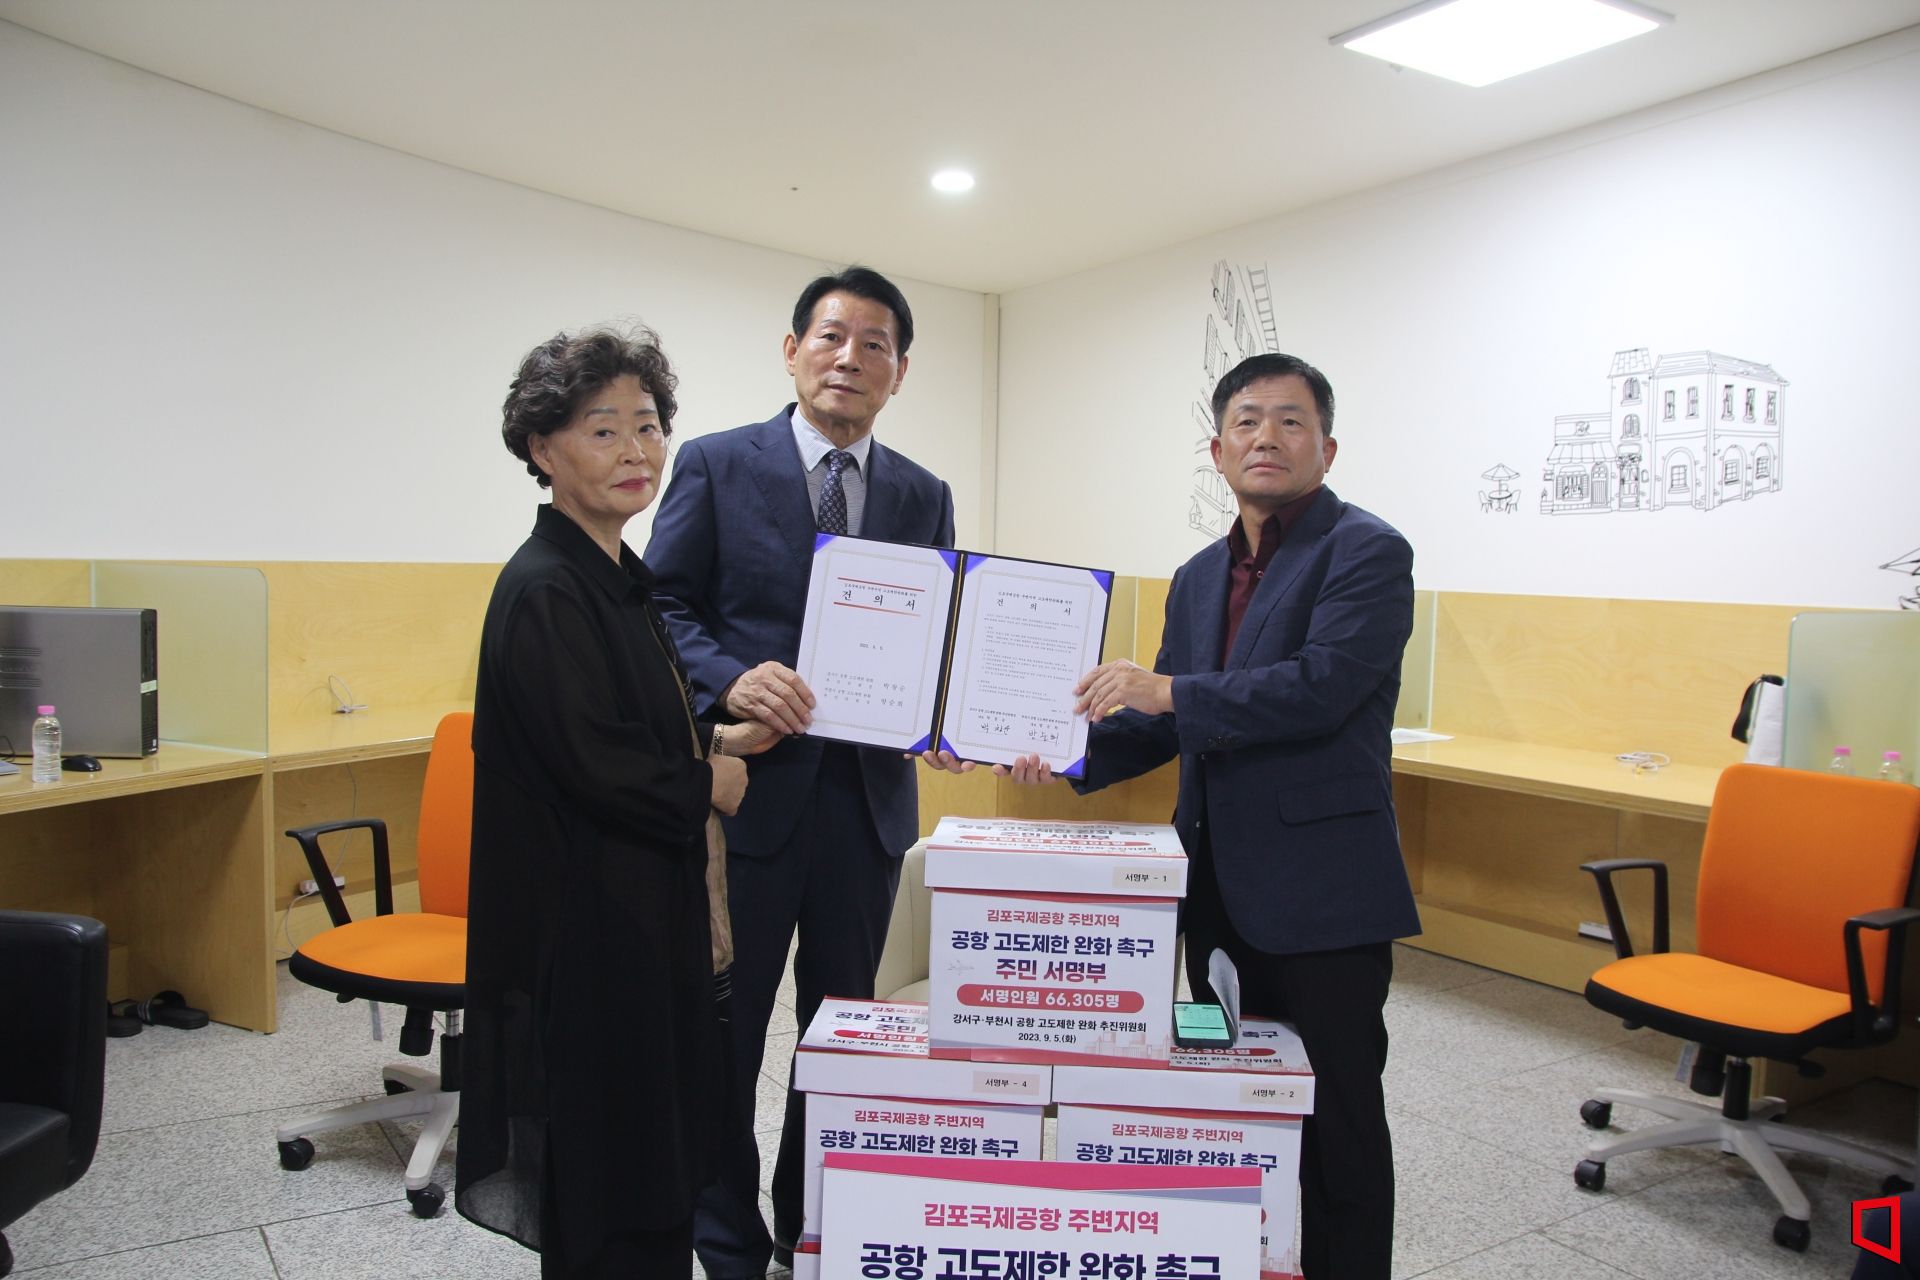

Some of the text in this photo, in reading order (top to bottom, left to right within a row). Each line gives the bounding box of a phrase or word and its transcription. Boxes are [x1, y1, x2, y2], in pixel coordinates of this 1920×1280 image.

[874, 595, 883, 606] 의
[905, 600, 915, 610] 서
[1125, 874, 1149, 882] 서명부
[987, 909, 1120, 927] 김포국제공항 주변지역
[952, 930, 1154, 958] 공항 고도제한 완화 촉구
[996, 958, 1106, 983] 주민 서명부
[980, 988, 1120, 1008] 서명인원 66,305명
[875, 1023, 917, 1033] 주민
[953, 1014, 1146, 1033] 강서구·부천시 공항 고도제한 완화 추진위원회
[1018, 1033, 1041, 1041] 2023.
[1054, 1034, 1076, 1044] 5.(화)
[985, 1079, 1009, 1087] 서명부
[1252, 1089, 1276, 1098] 서명부
[855, 1110, 984, 1128] 김포국제공항 주변지역
[1112, 1123, 1243, 1143] 김포국제공항 주변지역
[820, 1129, 1018, 1158] 공항 고도제한 완화 촉구
[1076, 1143, 1113, 1162] 공항
[1118, 1145, 1192, 1166] 고도제한
[1198, 1151, 1235, 1167] 완화
[924, 1203, 1159, 1235] 김포국제공항 주변지역
[860, 1243, 928, 1280] 공항
[936, 1248, 1070, 1280] 고도제한
[1079, 1252, 1146, 1280] 완화
